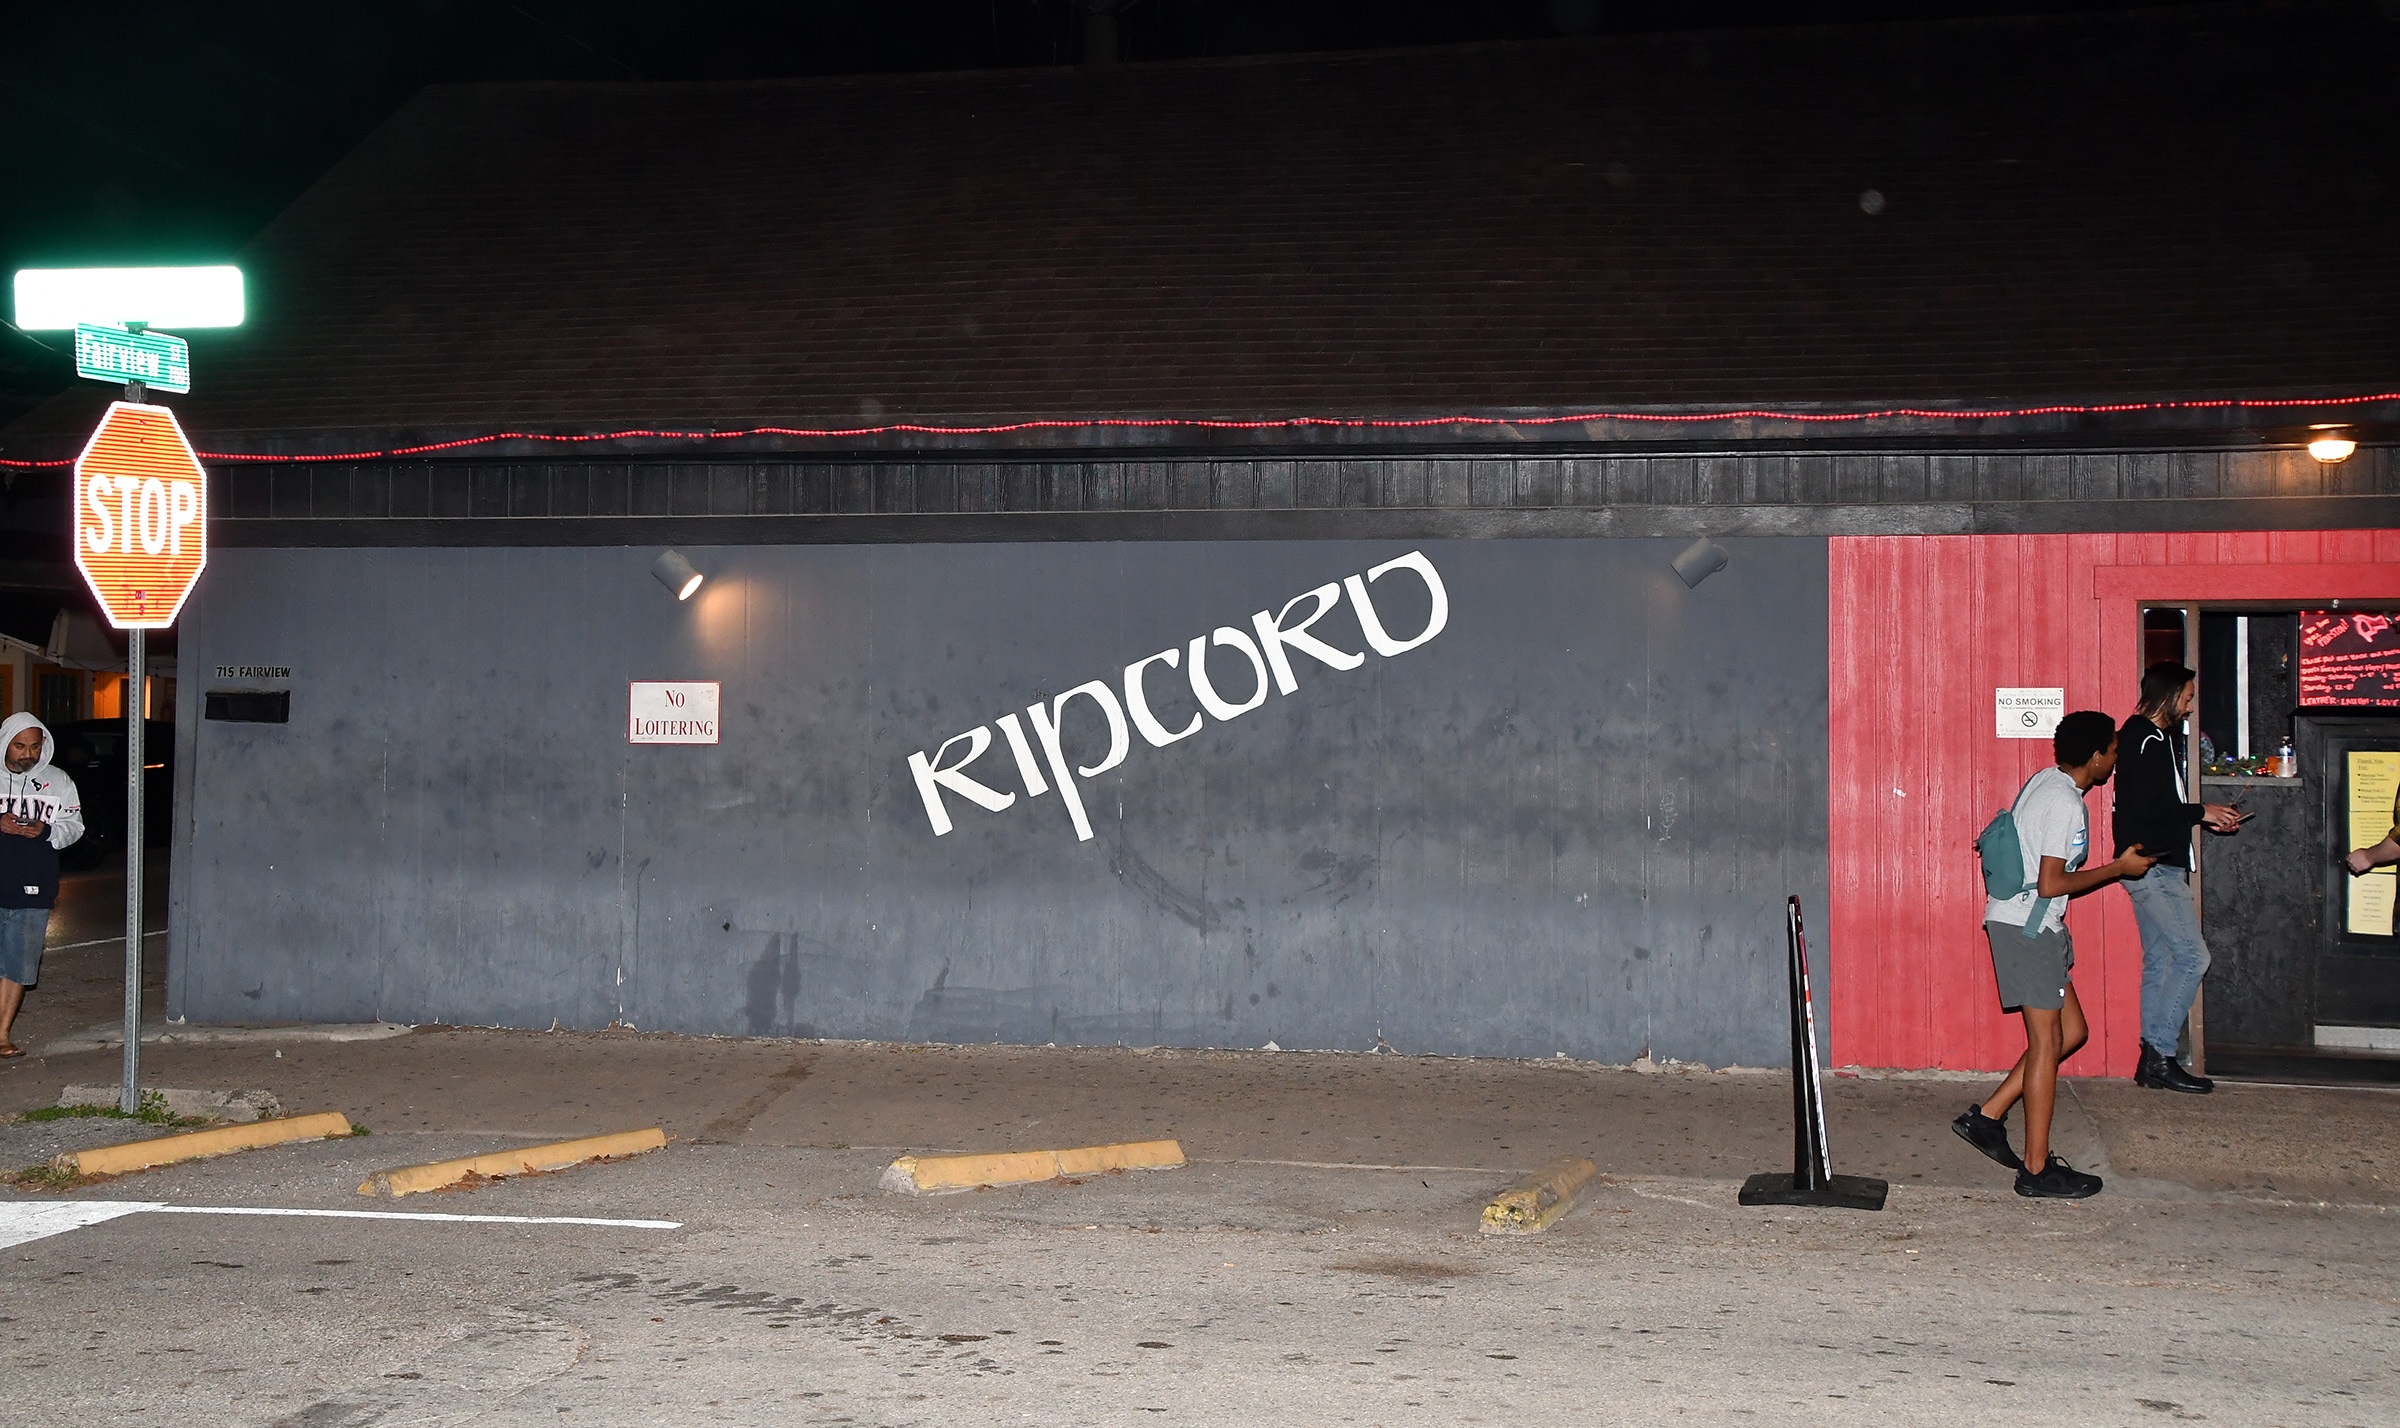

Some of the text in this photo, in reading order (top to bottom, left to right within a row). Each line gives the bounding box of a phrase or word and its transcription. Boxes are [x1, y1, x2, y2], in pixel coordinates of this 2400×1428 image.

[81, 333, 160, 377] Fairview
[86, 472, 198, 556] STOP
[2317, 618, 2350, 647] HOUSTON!
[216, 666, 292, 678] 715 FAIRVIEW
[907, 550, 1449, 842] RIPCORD
[1998, 697, 2061, 706] NO SMOKING
